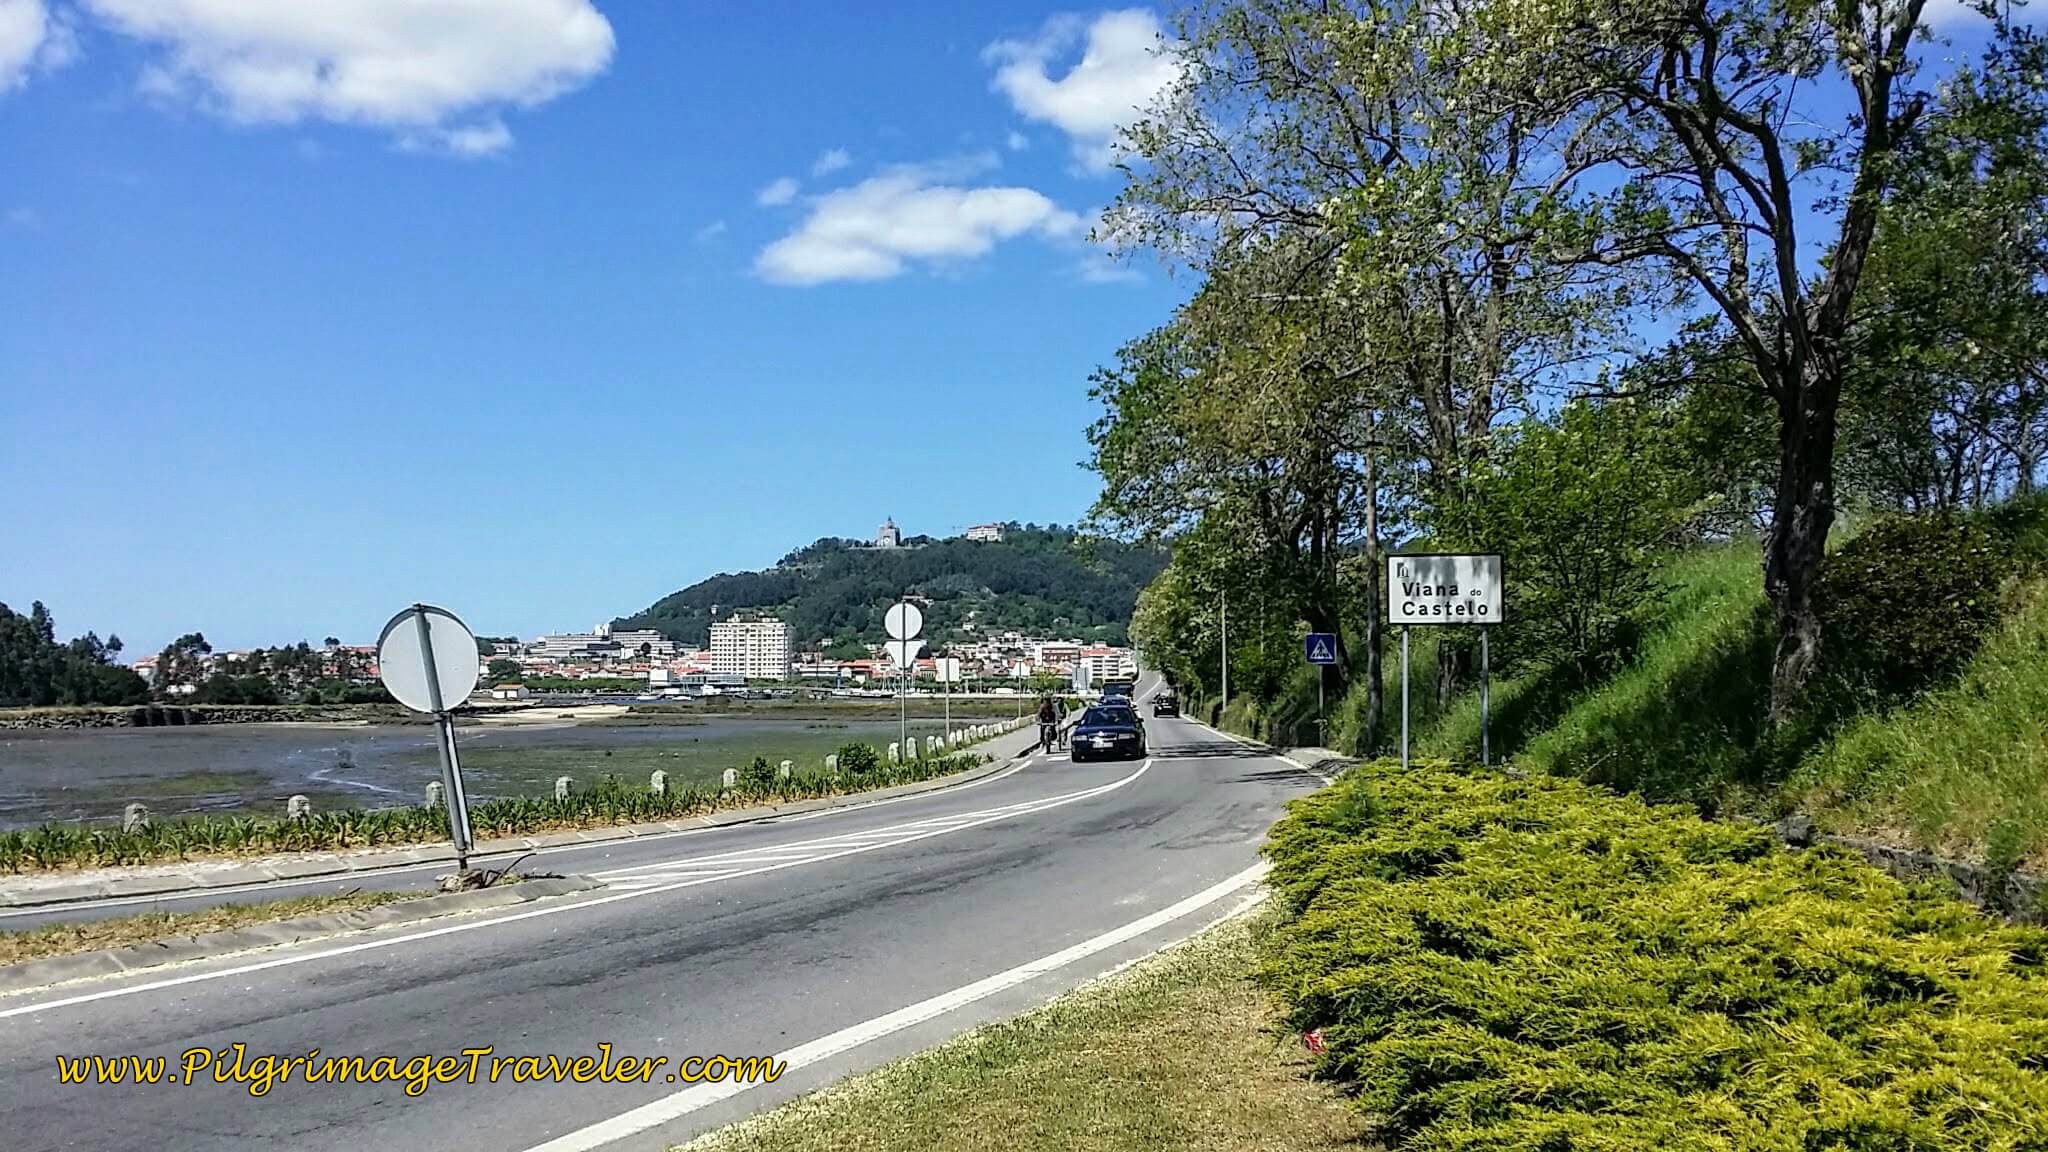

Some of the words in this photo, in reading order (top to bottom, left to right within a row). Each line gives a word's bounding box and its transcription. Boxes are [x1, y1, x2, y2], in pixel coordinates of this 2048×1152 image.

[1402, 582, 1459, 597] Viana
[1470, 588, 1482, 597] do
[1402, 601, 1488, 616] Castelo
